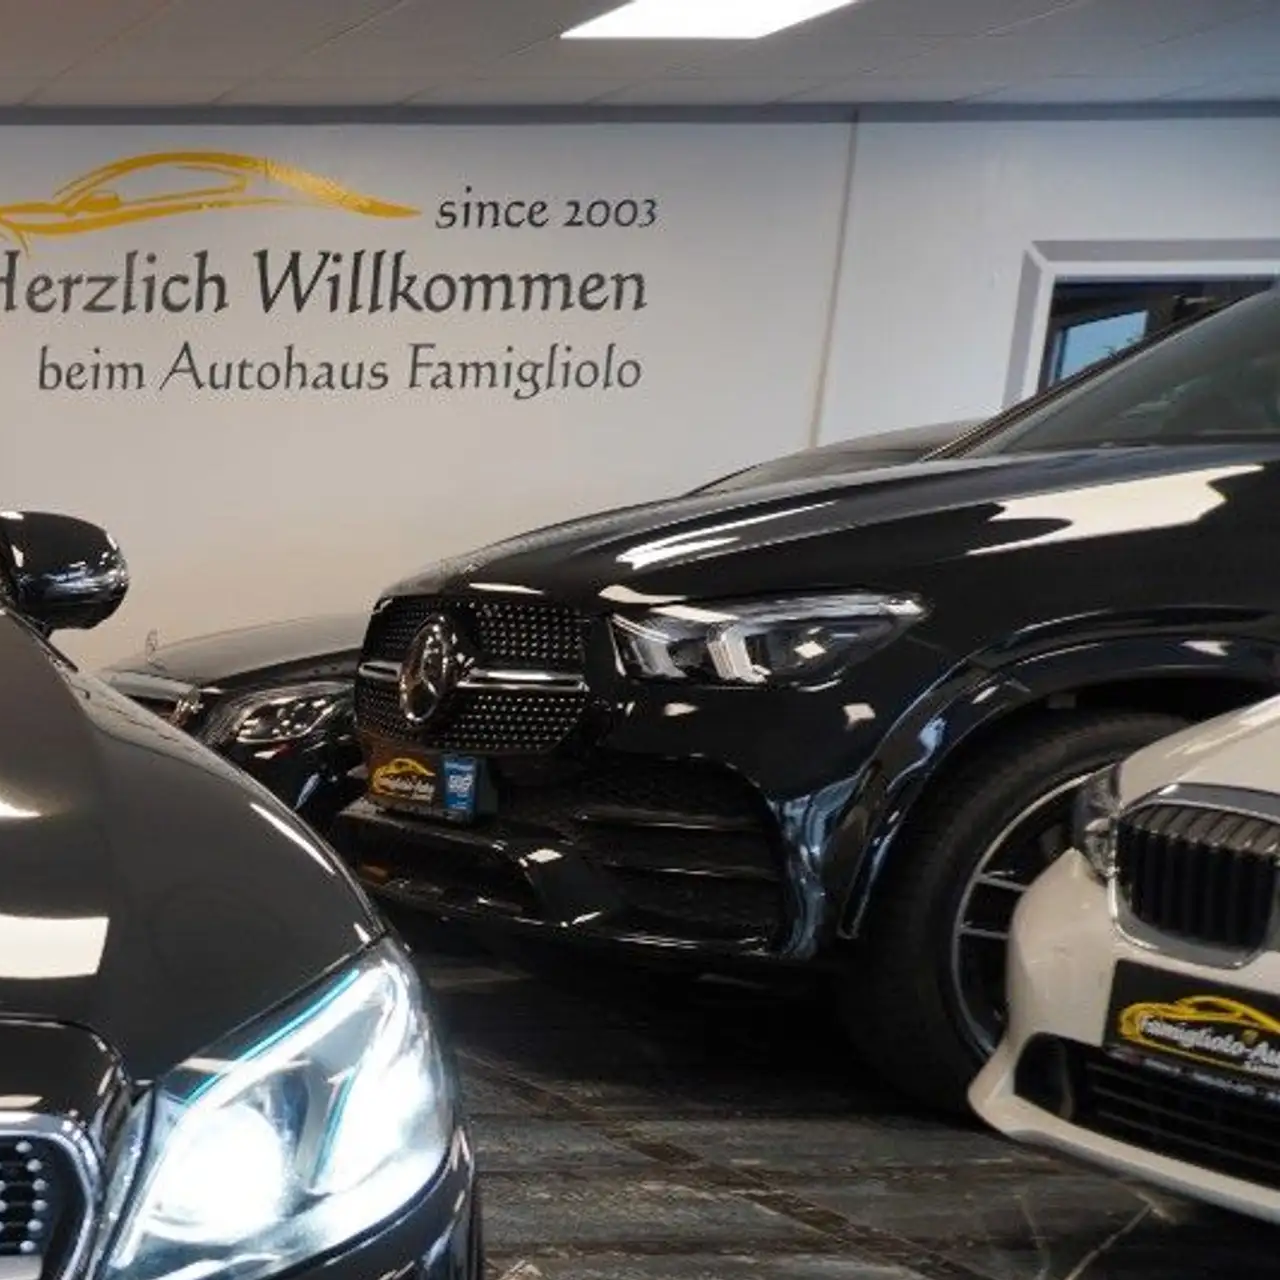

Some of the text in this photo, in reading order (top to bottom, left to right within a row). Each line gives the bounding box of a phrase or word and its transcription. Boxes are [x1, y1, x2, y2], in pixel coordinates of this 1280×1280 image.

[435, 186, 657, 229] since 2003
[252, 249, 647, 314] Willkommen
[38, 340, 643, 401] beim Autohaus Famigliolo
